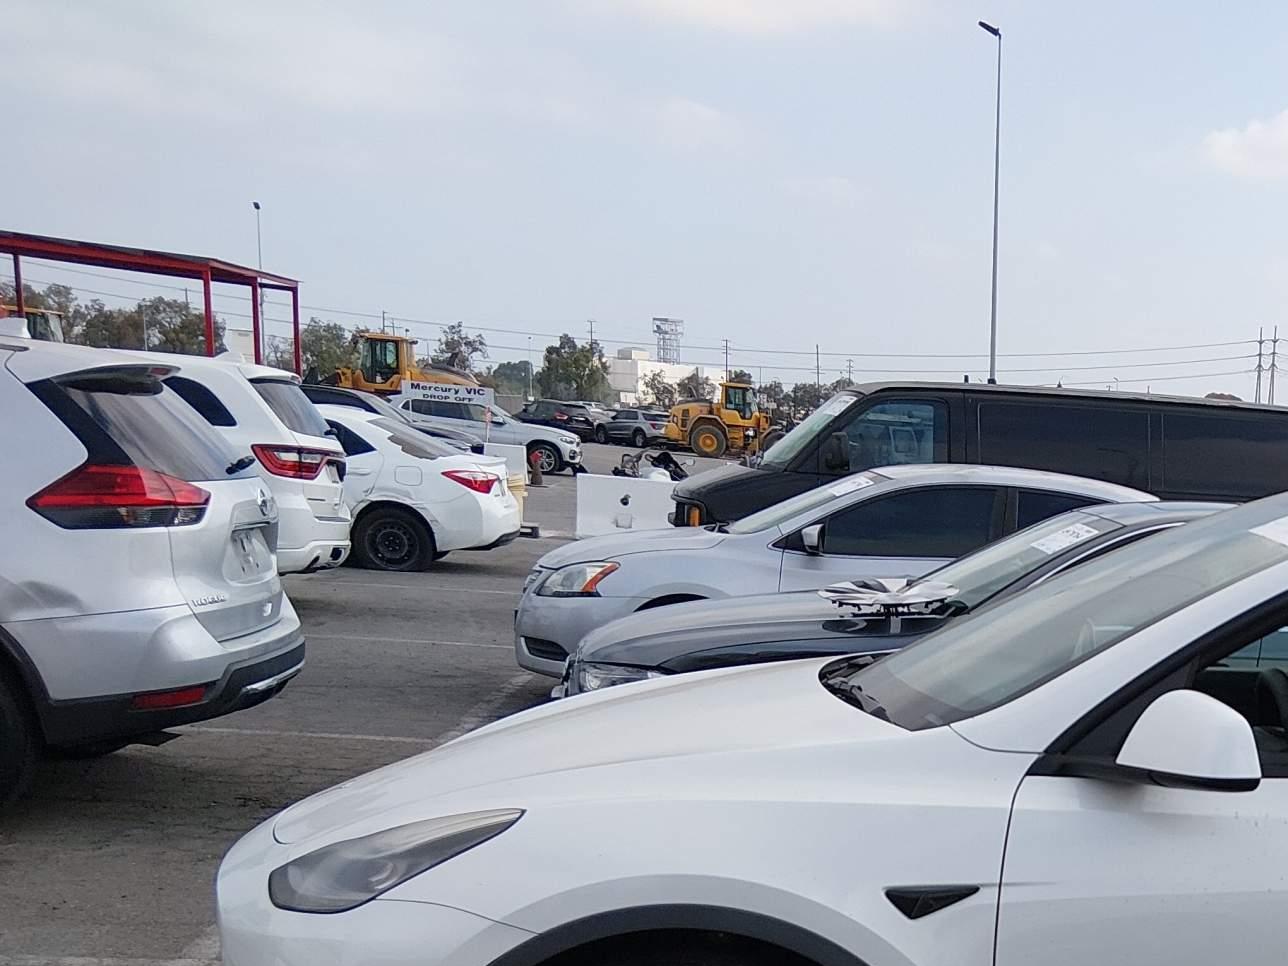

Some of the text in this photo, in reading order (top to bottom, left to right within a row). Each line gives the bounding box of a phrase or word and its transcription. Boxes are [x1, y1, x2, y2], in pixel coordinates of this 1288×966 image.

[410, 382, 486, 396] Mercury VIC
[422, 393, 450, 401] DROP
